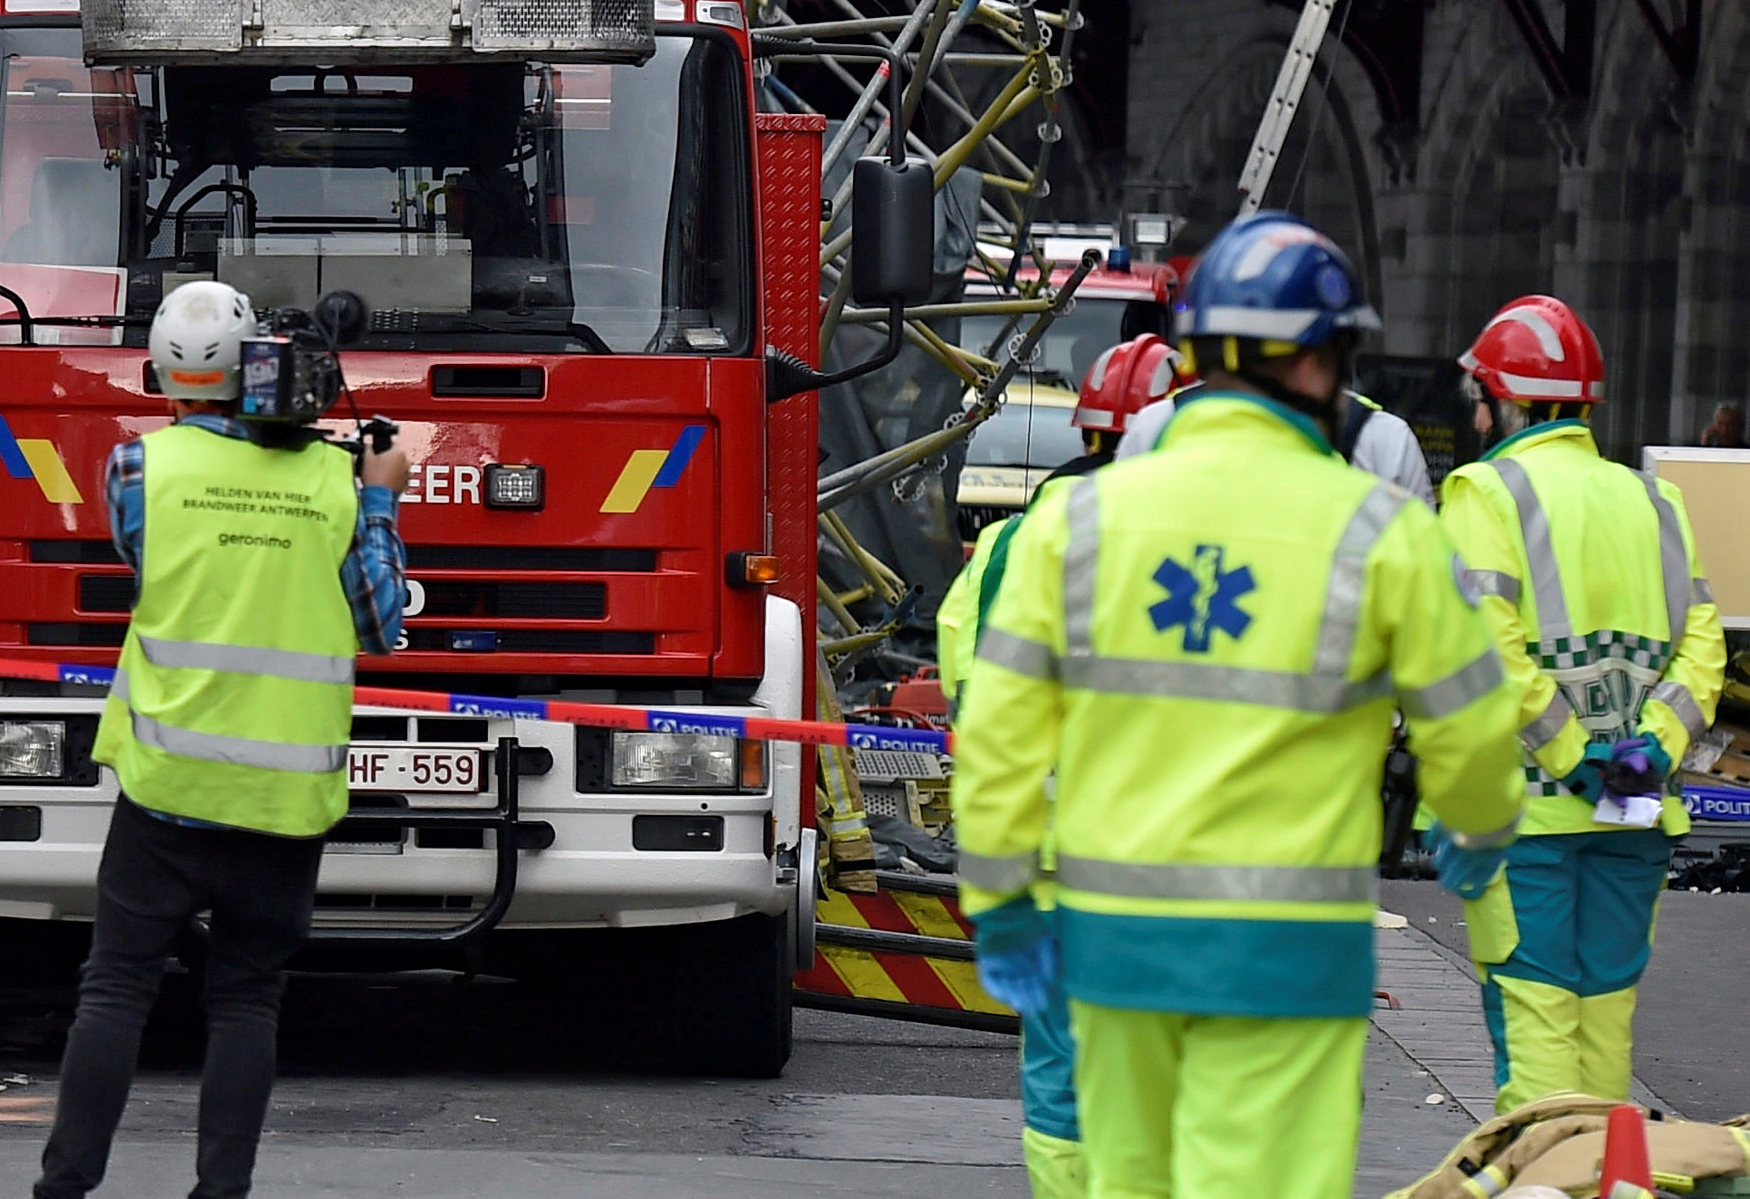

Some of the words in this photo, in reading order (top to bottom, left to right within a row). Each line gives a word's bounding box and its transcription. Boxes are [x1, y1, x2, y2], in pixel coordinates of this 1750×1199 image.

[205, 486, 253, 499] HELDEN
[256, 489, 281, 500] VAN
[285, 493, 311, 504] HIER
[183, 498, 256, 513] BRANDWEER
[260, 504, 329, 522] ANTWERPEN
[218, 532, 292, 550] geronimo
[880, 738, 940, 753] POLITIE
